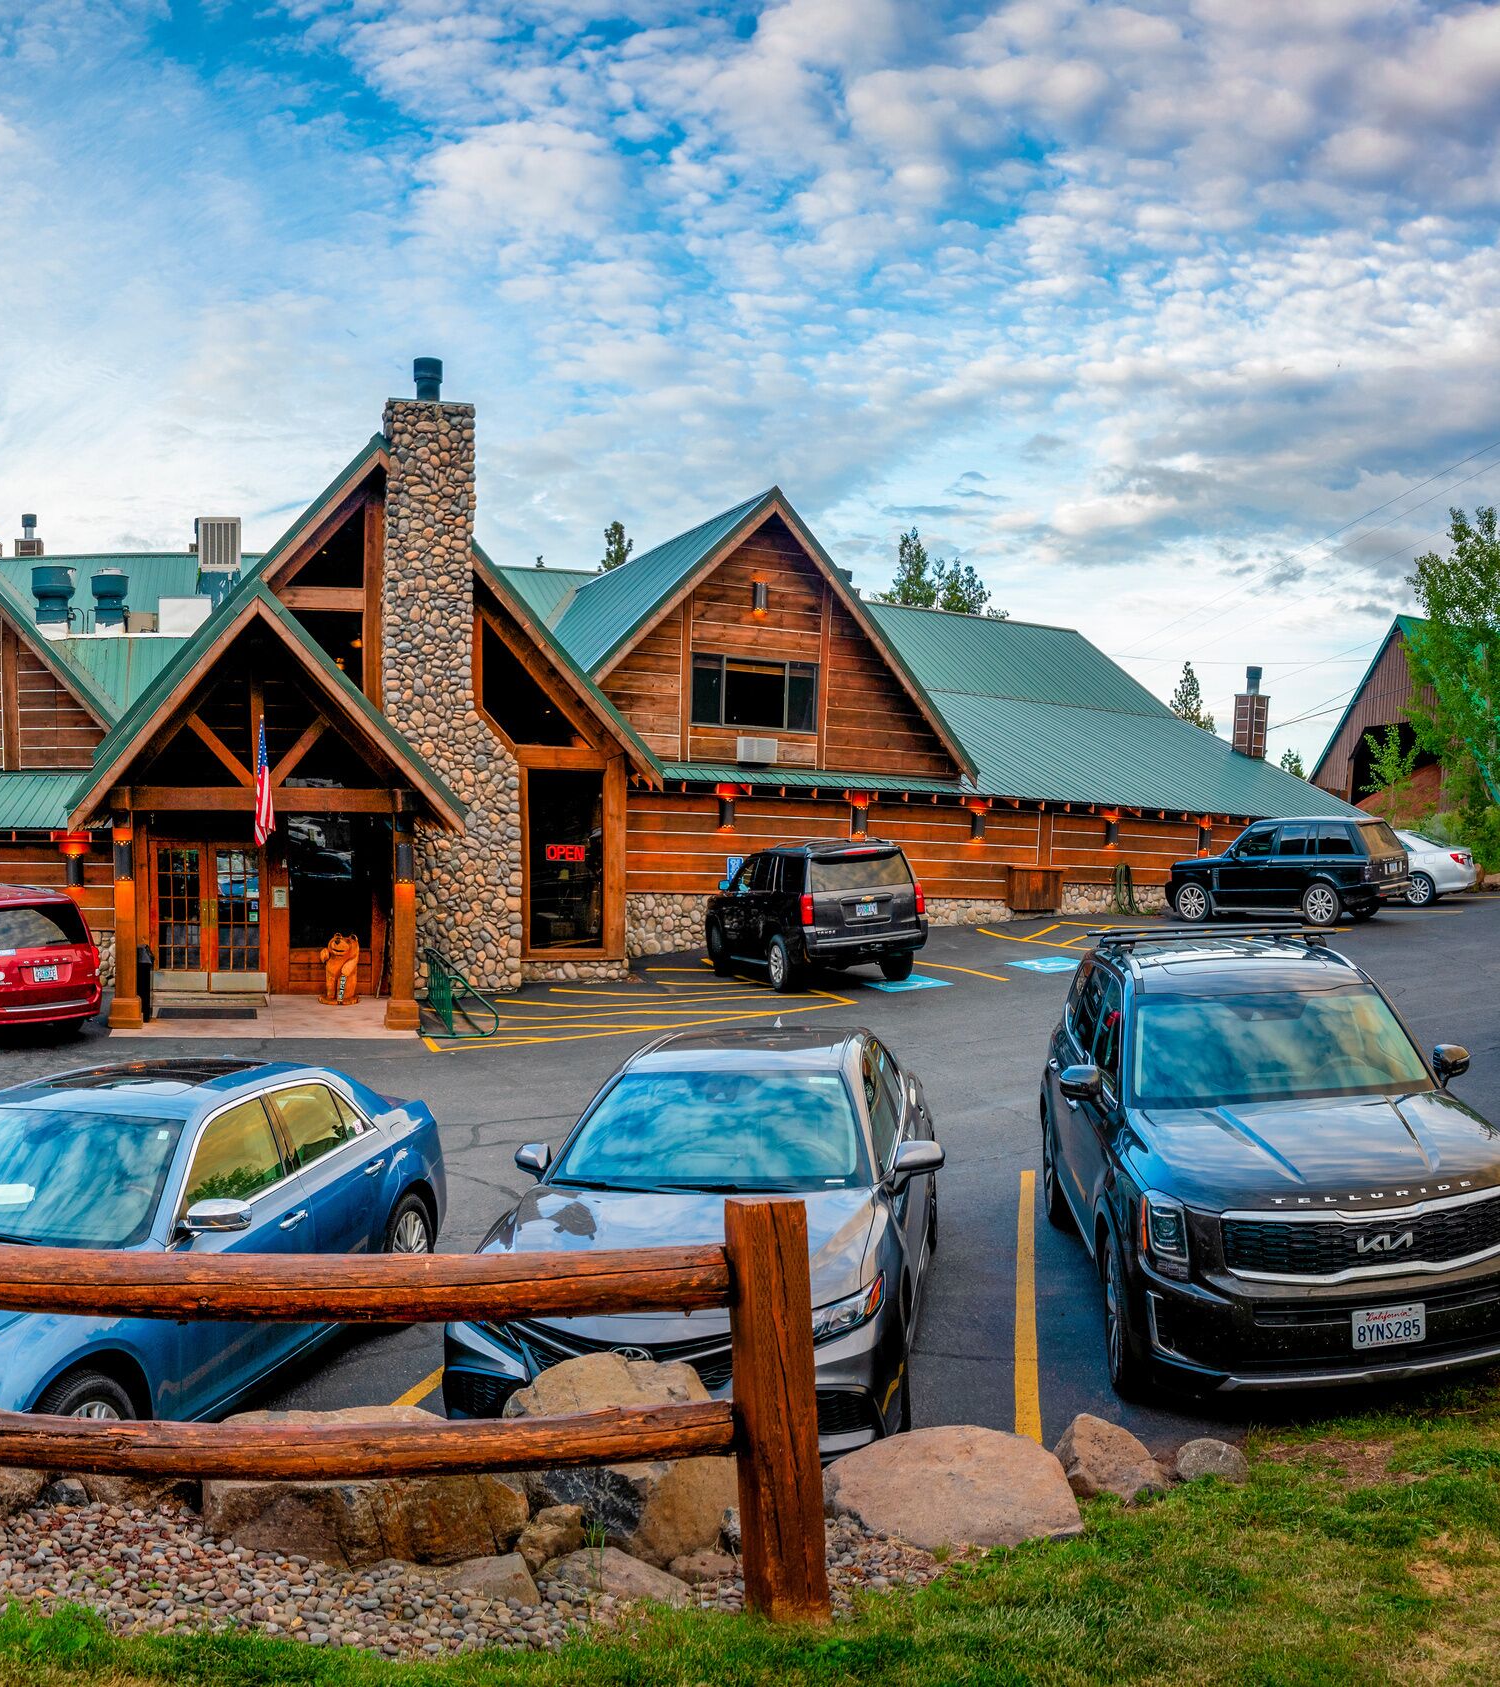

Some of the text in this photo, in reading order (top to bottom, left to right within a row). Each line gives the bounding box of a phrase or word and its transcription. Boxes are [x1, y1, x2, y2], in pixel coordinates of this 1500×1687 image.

[547, 845, 585, 860] OPEN
[1271, 1180, 1471, 1204] TELLURIDE
[1356, 1232, 1413, 1254] KIA
[1366, 1310, 1411, 1322] California
[1357, 1319, 1421, 1343] 8YNS285
